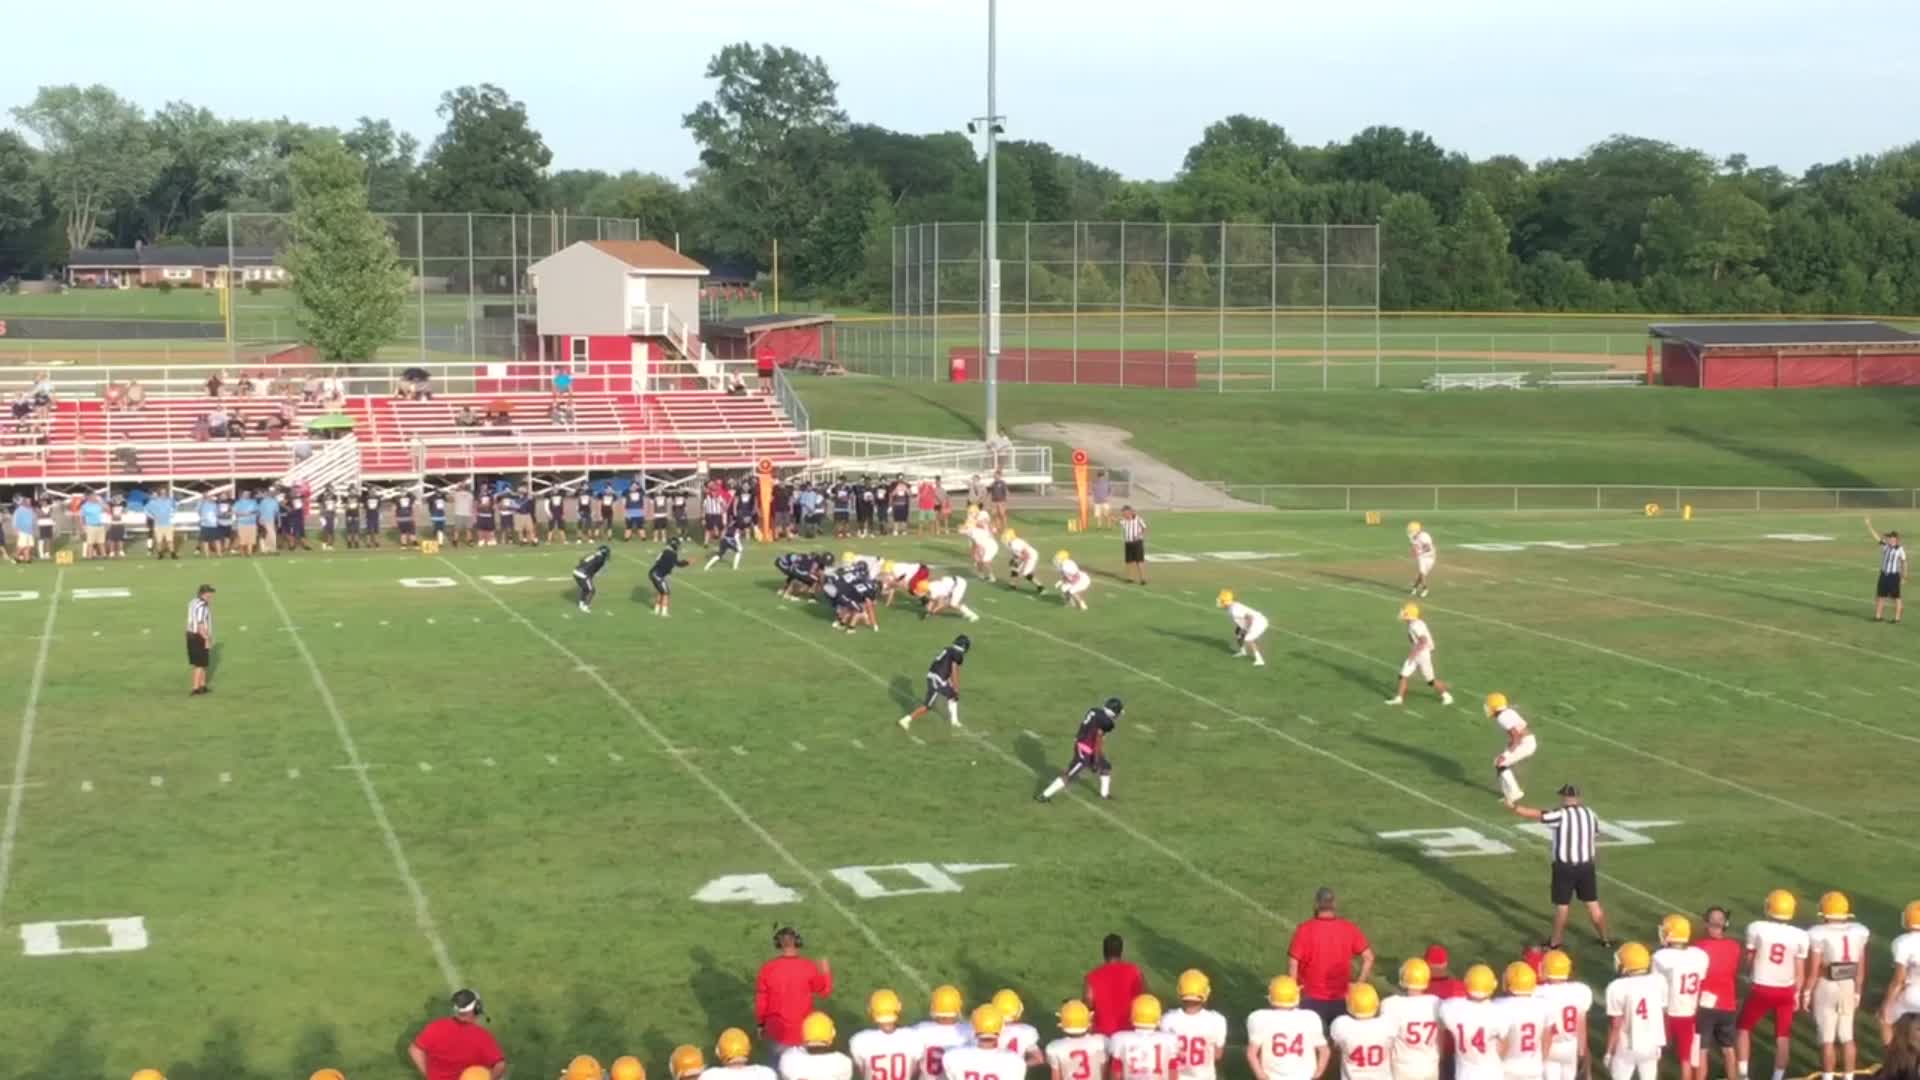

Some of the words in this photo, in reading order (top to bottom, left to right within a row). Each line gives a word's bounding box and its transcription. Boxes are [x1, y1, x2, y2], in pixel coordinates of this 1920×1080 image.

[690, 862, 965, 904] 40
[1842, 935, 1850, 961] 1
[1680, 973, 1698, 995] 13
[1636, 998, 1648, 1020] 4
[1272, 1033, 1303, 1057] 64
[1406, 1022, 1437, 1045] 57
[1457, 1023, 1486, 1053] 14
[1520, 1023, 1535, 1052] 2
[1070, 1050, 1091, 1079] 3
[1350, 1045, 1383, 1067] 40
